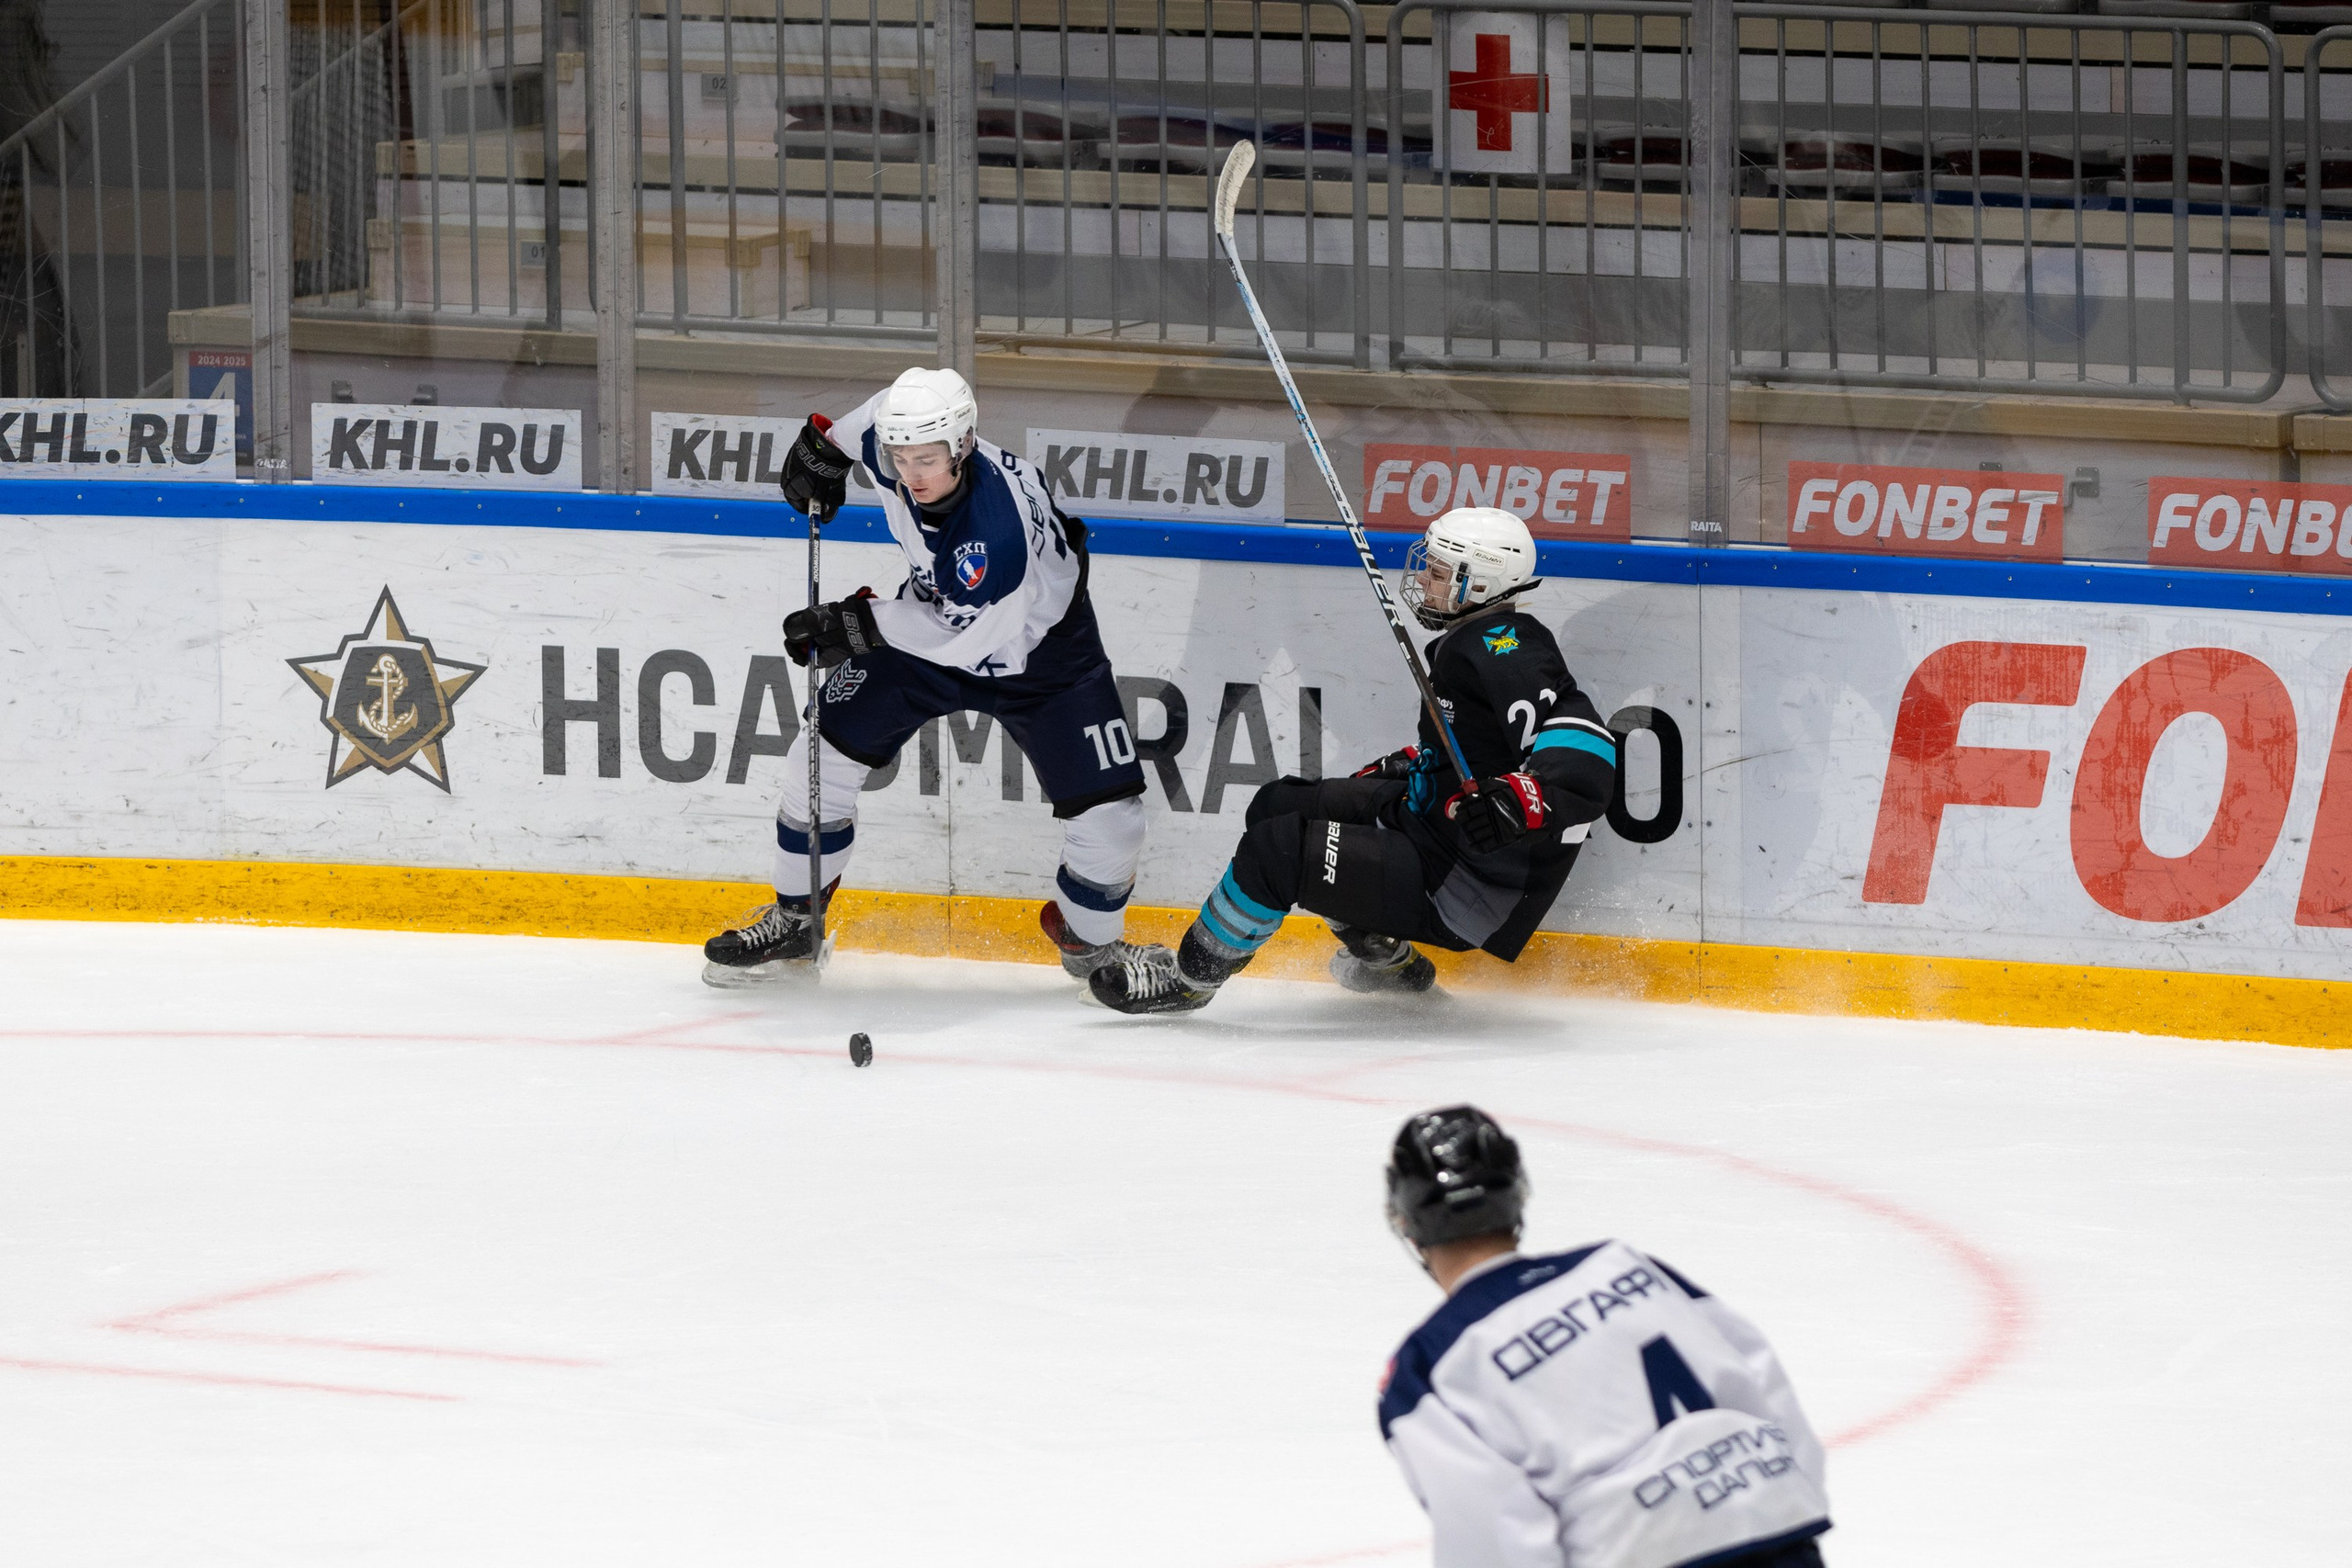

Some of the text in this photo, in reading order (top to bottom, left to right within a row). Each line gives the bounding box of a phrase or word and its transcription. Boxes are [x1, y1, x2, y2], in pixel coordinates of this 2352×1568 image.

[198, 355, 246, 367] 2024 2025
[329, 418, 564, 475] KHL.RU
[1044, 445, 1270, 508] KHL.RU
[1368, 459, 1627, 525] FONBET
[1792, 478, 2058, 546] FONBET
[1690, 520, 1723, 533] RAITA
[1083, 717, 1136, 771] 10
[1861, 640, 2352, 928] FO
[1323, 820, 1340, 885] BAUER
[1492, 1266, 1668, 1381] ДВГАФ
